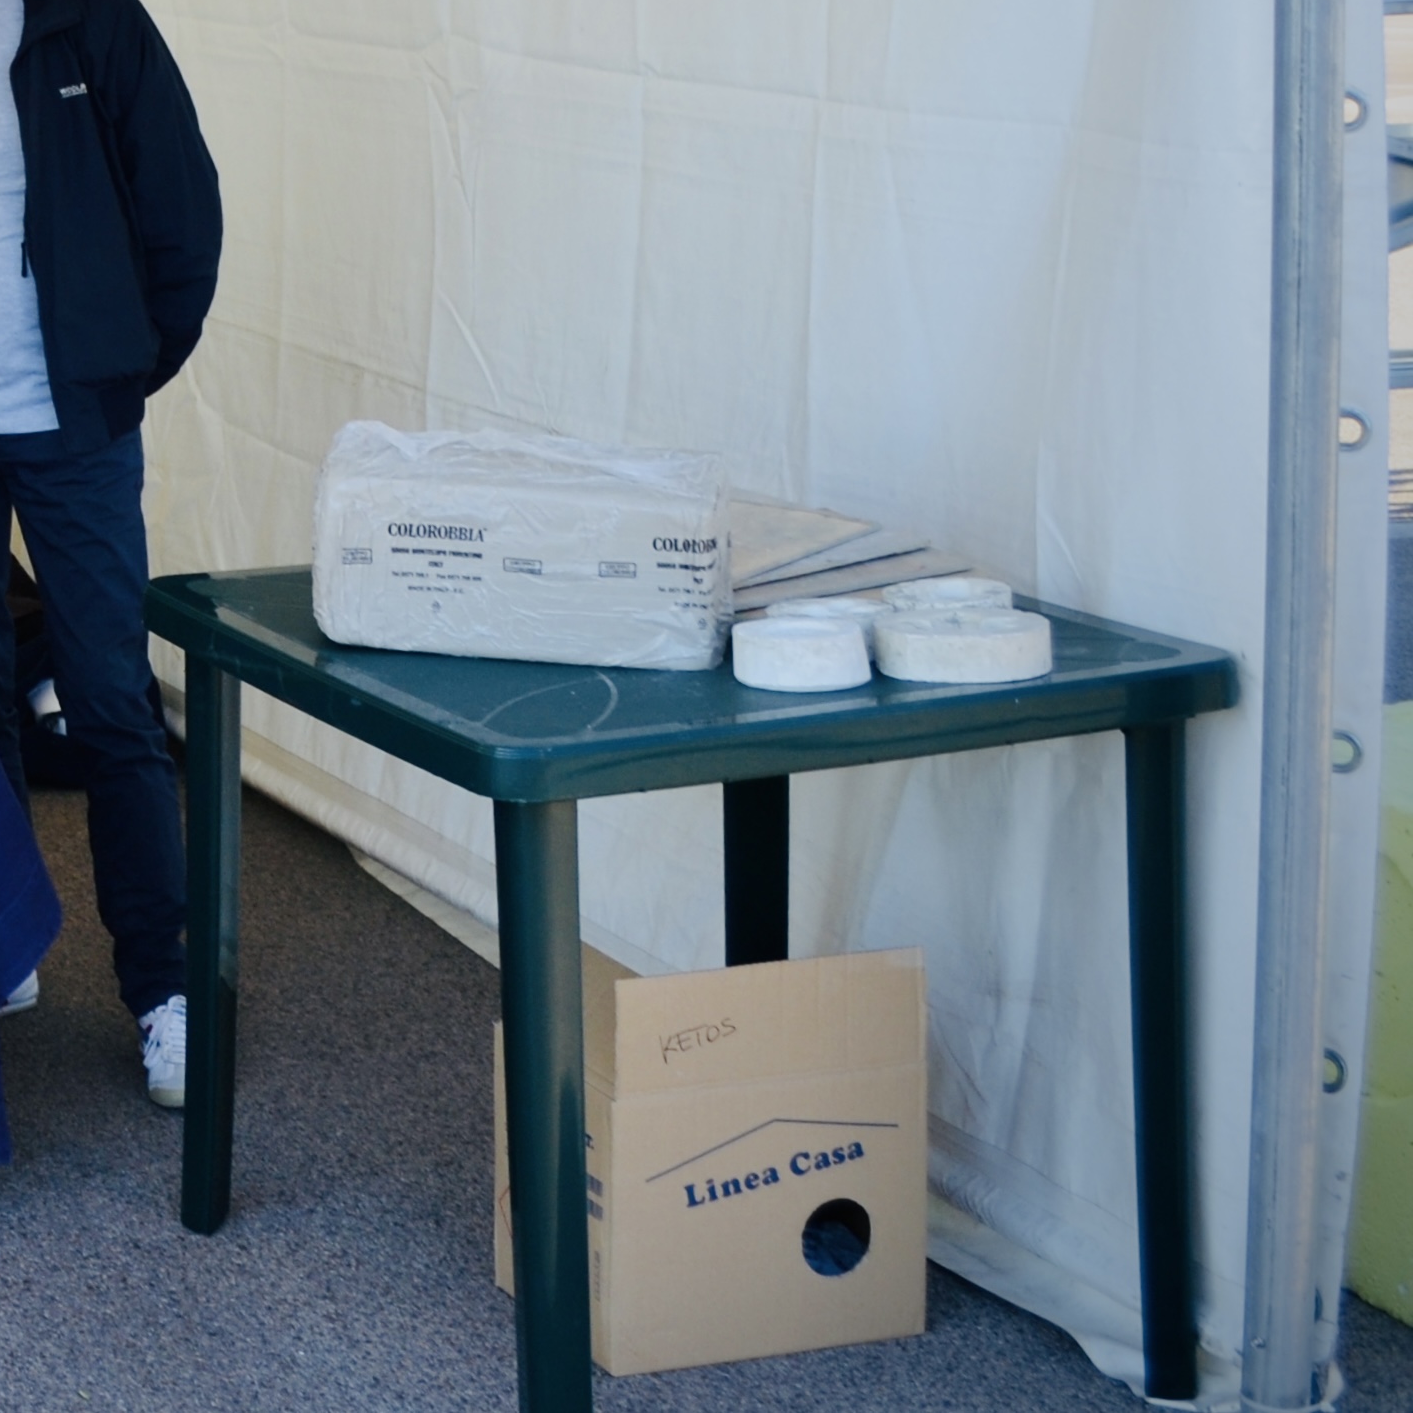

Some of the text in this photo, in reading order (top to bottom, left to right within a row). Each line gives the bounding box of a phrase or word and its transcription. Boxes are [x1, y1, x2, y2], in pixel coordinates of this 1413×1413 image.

[387, 522, 485, 542] COLOROBBIA
[658, 1017, 737, 1065] KETOS
[683, 1140, 866, 1208] Linea Casa
